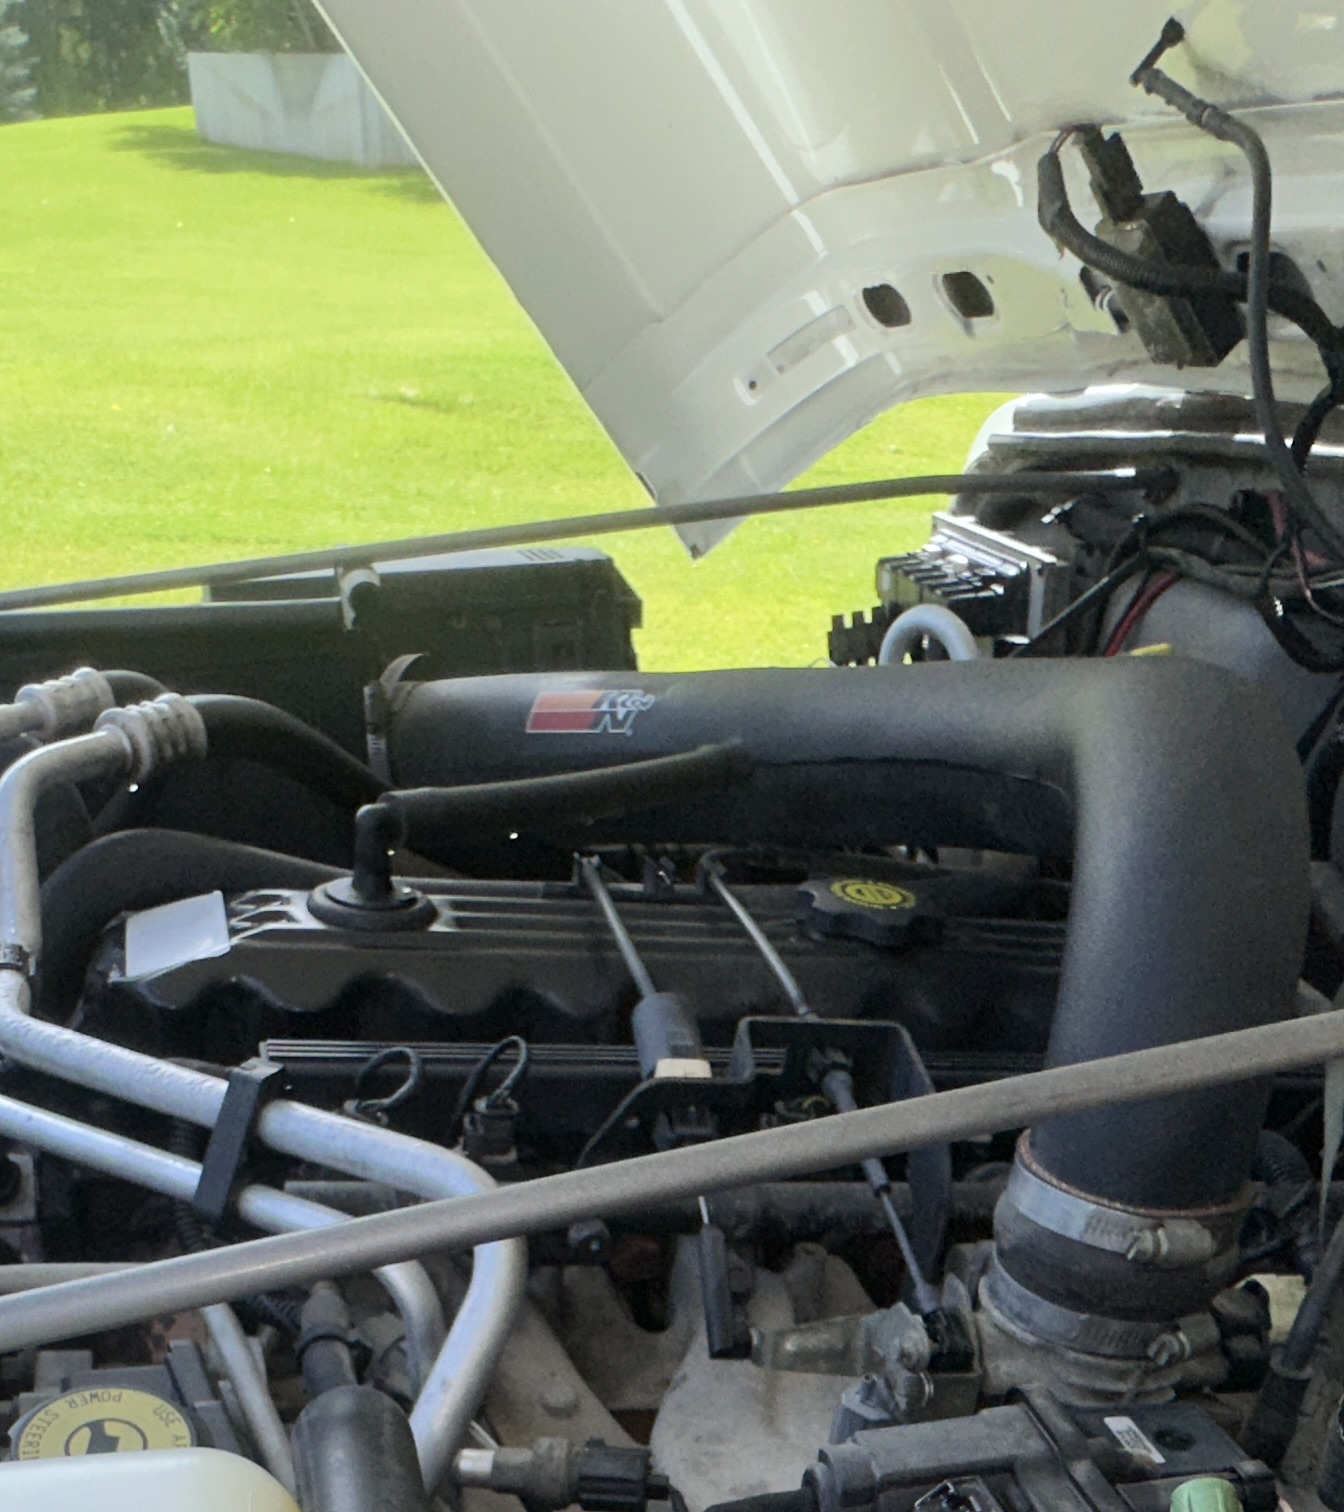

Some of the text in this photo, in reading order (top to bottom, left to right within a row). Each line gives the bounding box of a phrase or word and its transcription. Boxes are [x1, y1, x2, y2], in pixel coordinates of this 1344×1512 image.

[22, 1390, 124, 1460] POWER STEERI
[152, 1403, 182, 1429] USE
